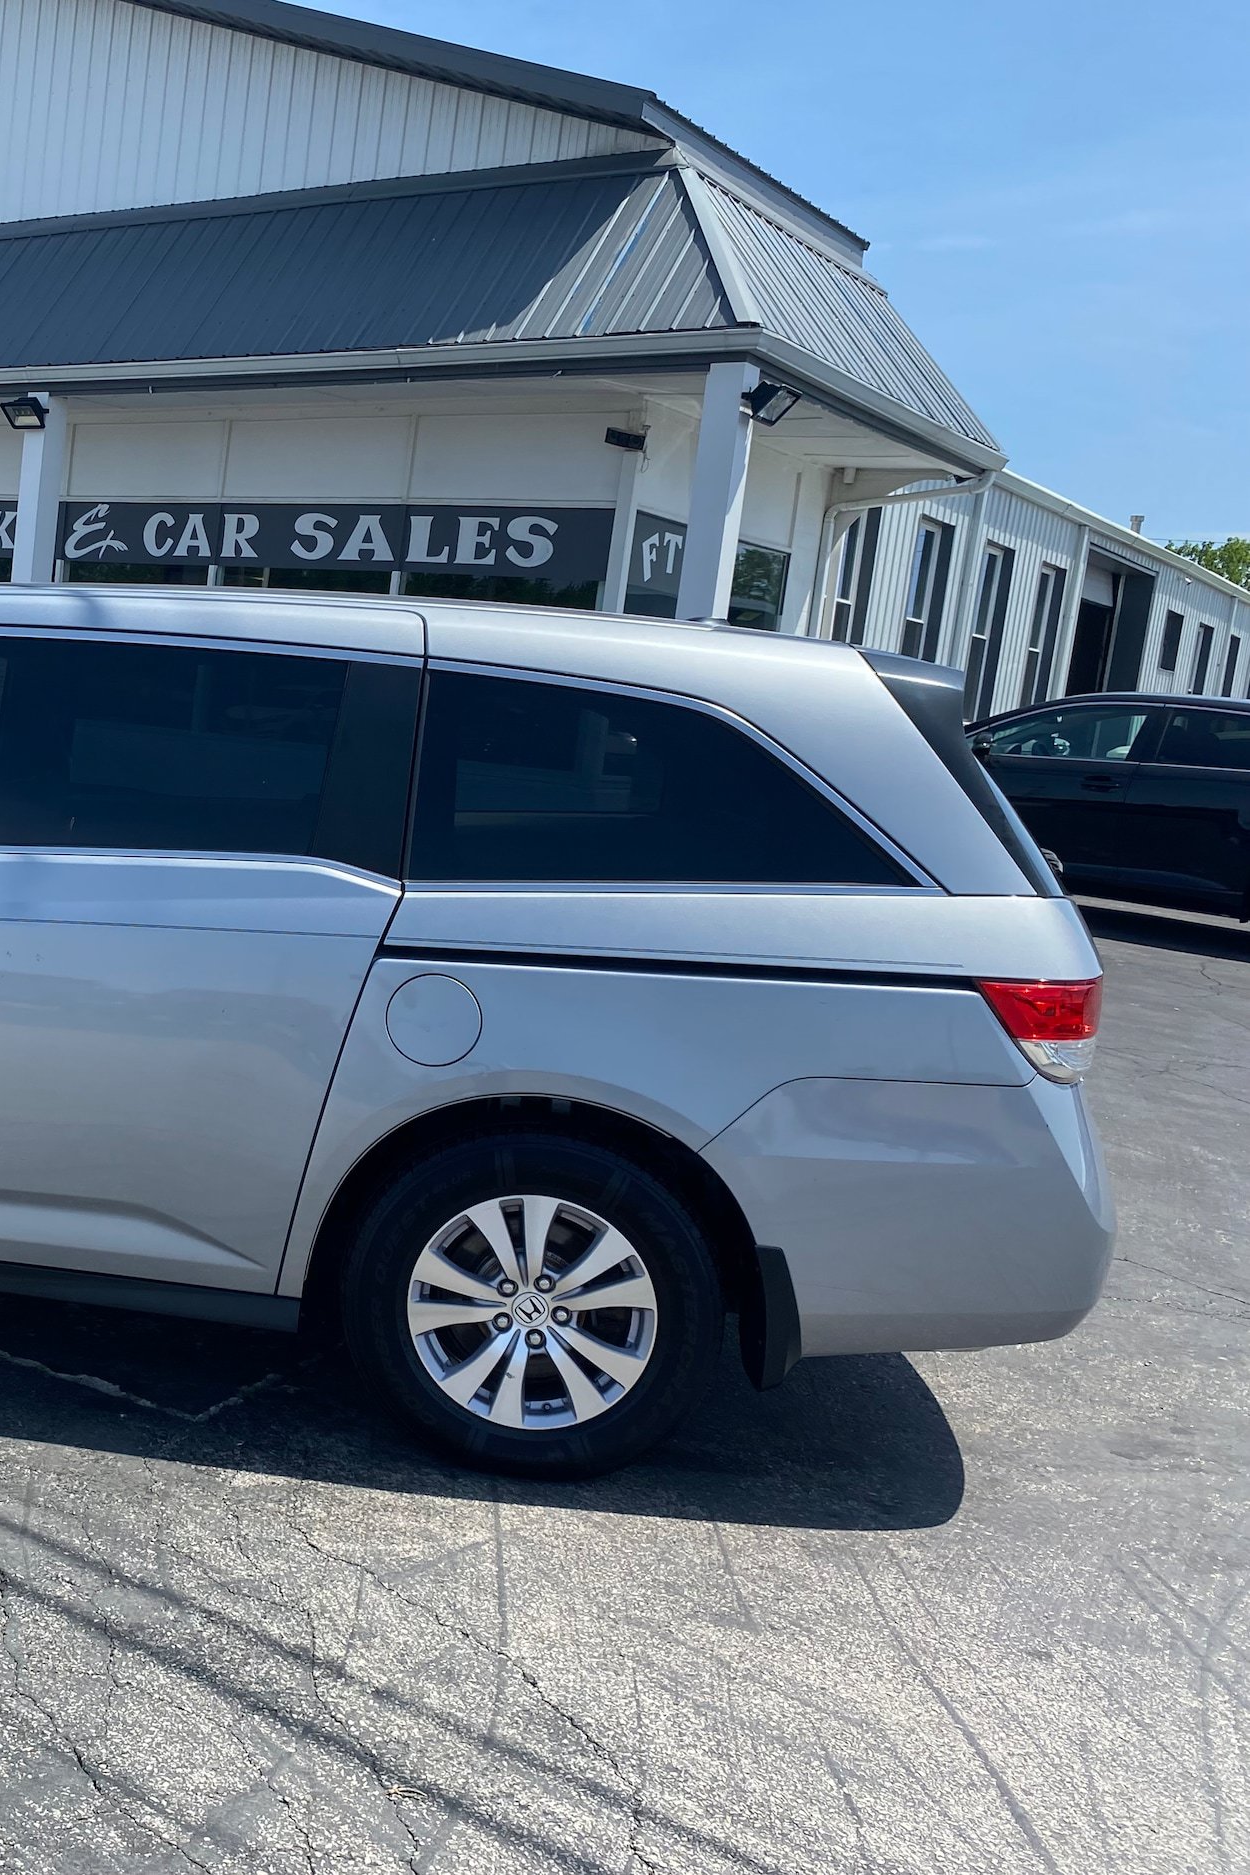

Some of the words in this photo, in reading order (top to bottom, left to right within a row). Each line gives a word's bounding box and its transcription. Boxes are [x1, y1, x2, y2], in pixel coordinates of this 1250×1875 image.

[143, 512, 260, 558] CAR
[290, 512, 559, 568] SALES
[642, 532, 684, 583] FT
